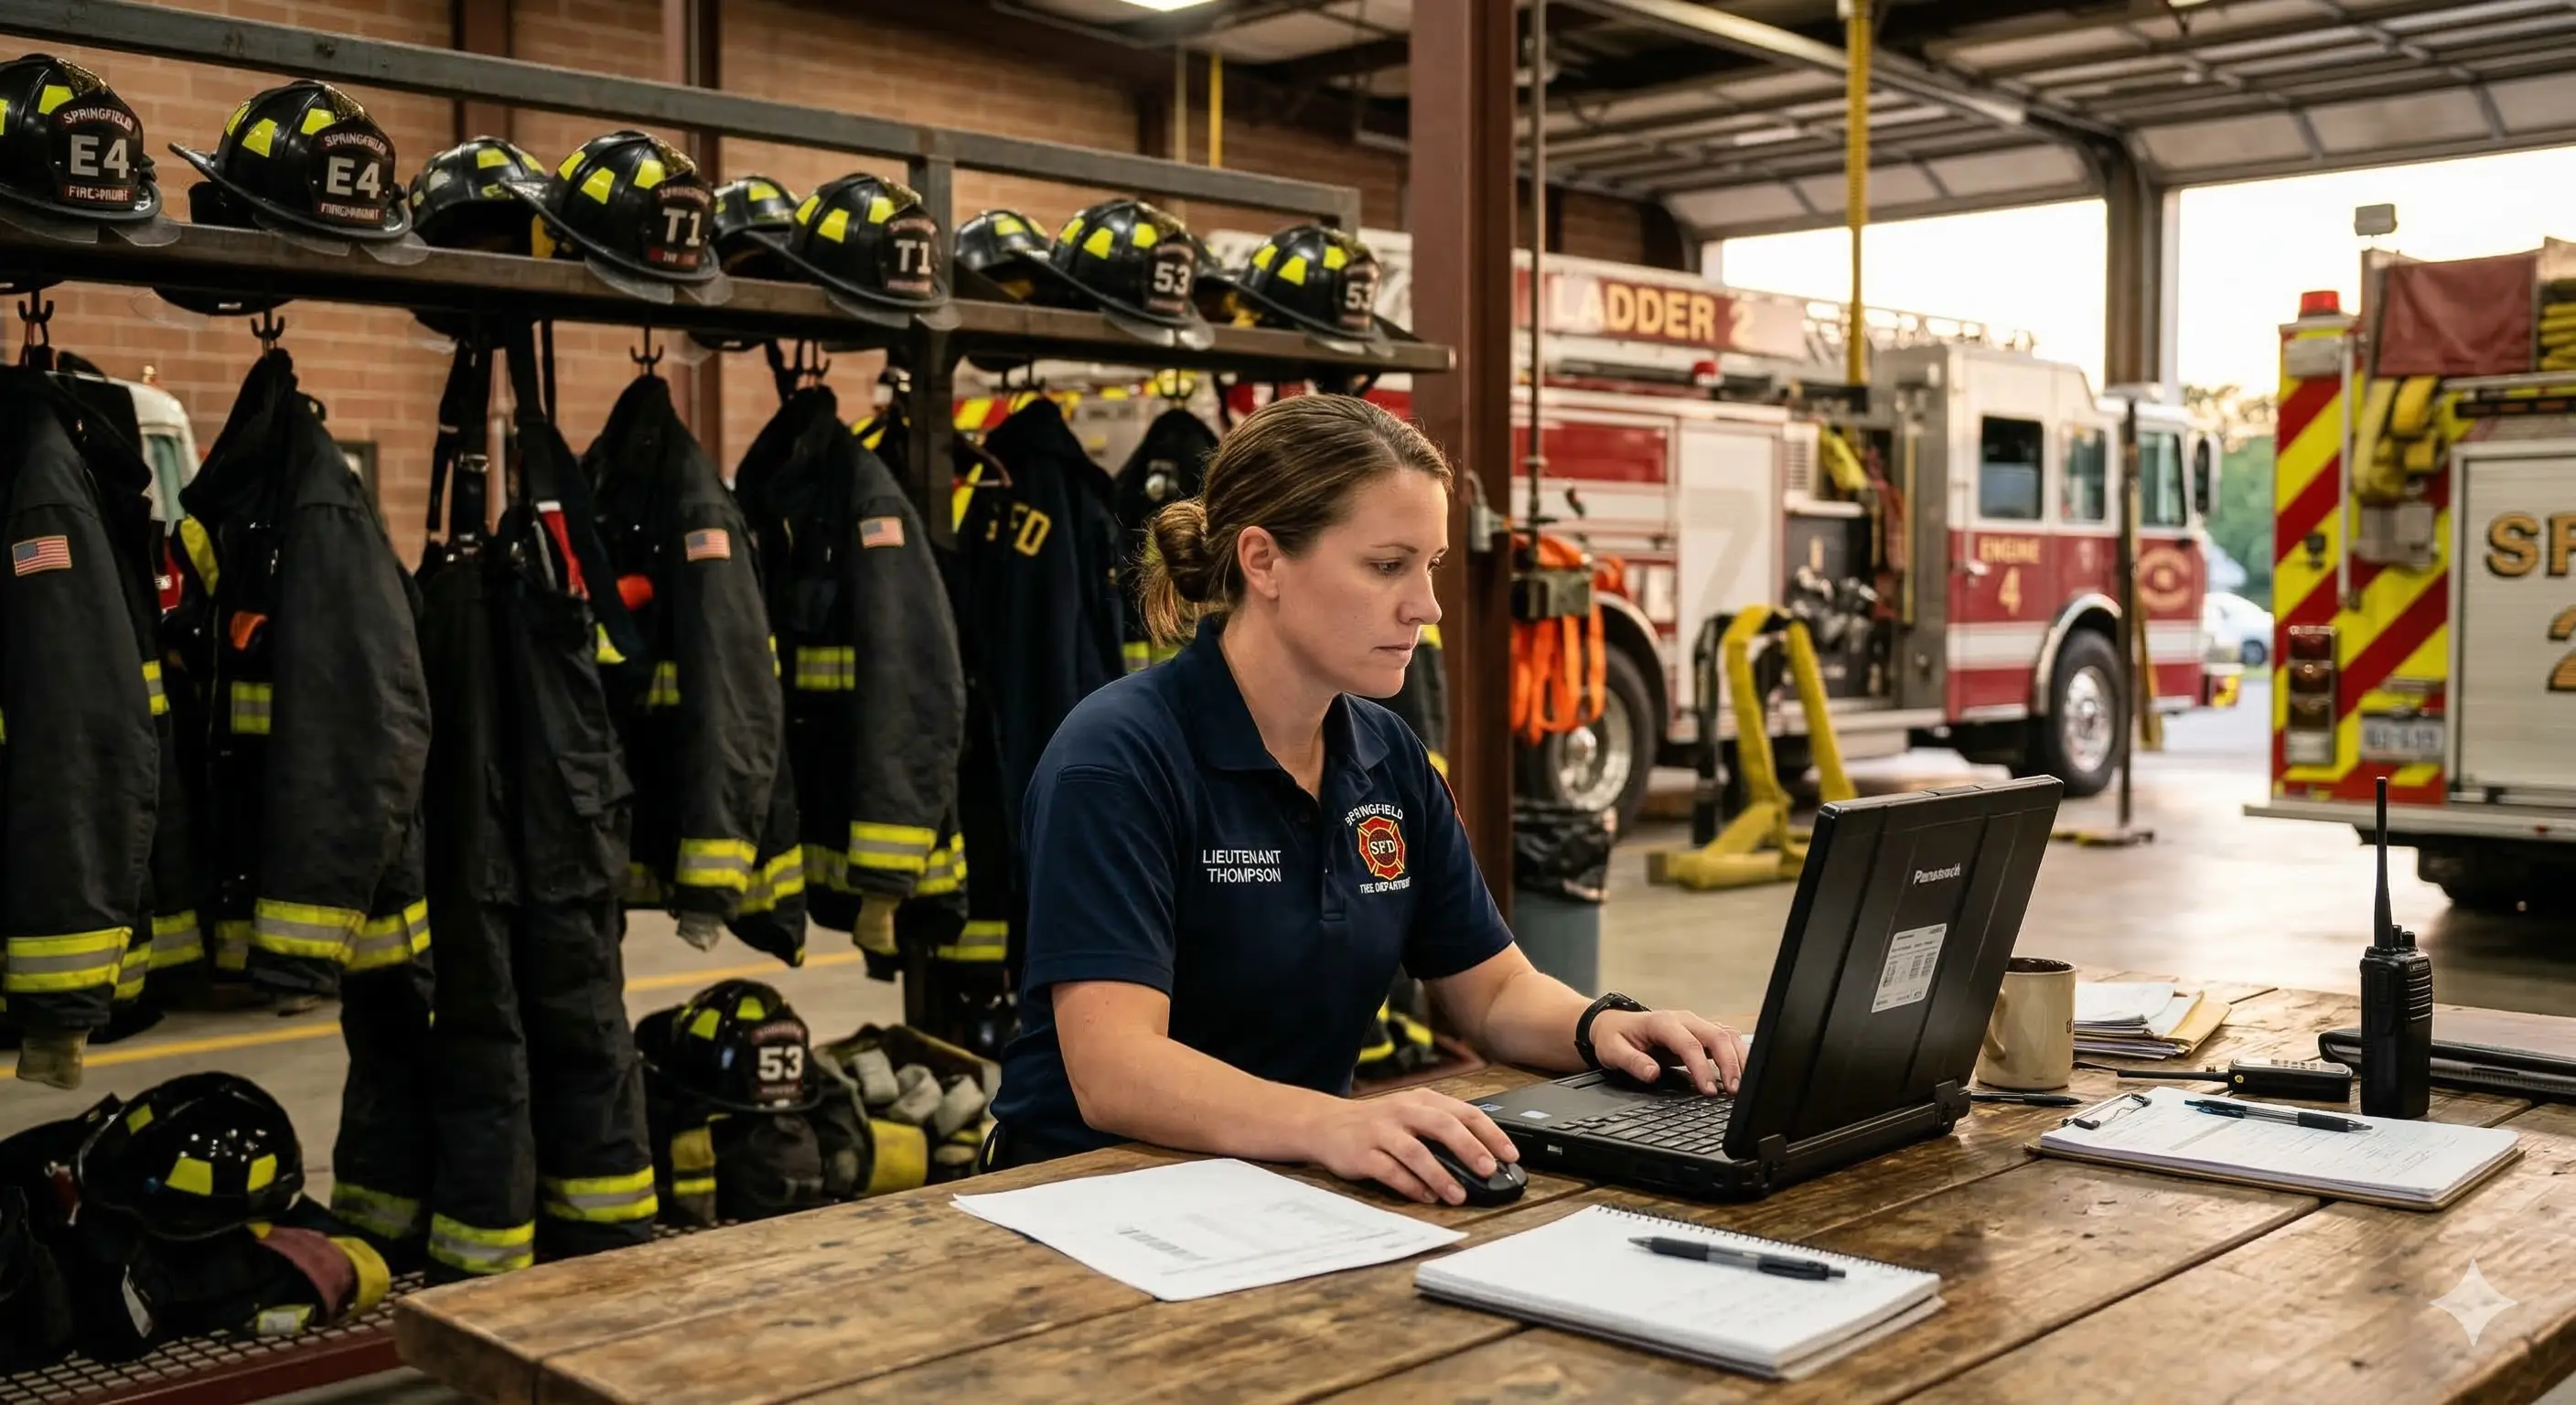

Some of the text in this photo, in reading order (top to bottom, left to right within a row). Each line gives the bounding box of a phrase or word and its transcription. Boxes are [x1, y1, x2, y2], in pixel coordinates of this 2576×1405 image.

[70, 134, 130, 178] E4
[326, 156, 381, 199] E4
[662, 207, 701, 247] T1
[895, 239, 931, 274] T1
[1154, 261, 1191, 295] 53
[1552, 276, 1755, 348] LADDER 2
[1979, 535, 2041, 563] ENGINE
[1998, 565, 2023, 617] 4
[1202, 849, 1282, 864] LIEUTENANT
[1369, 840, 1396, 855] SFD
[1207, 867, 1282, 884] THOMPSON
[757, 1046, 804, 1081] 53
